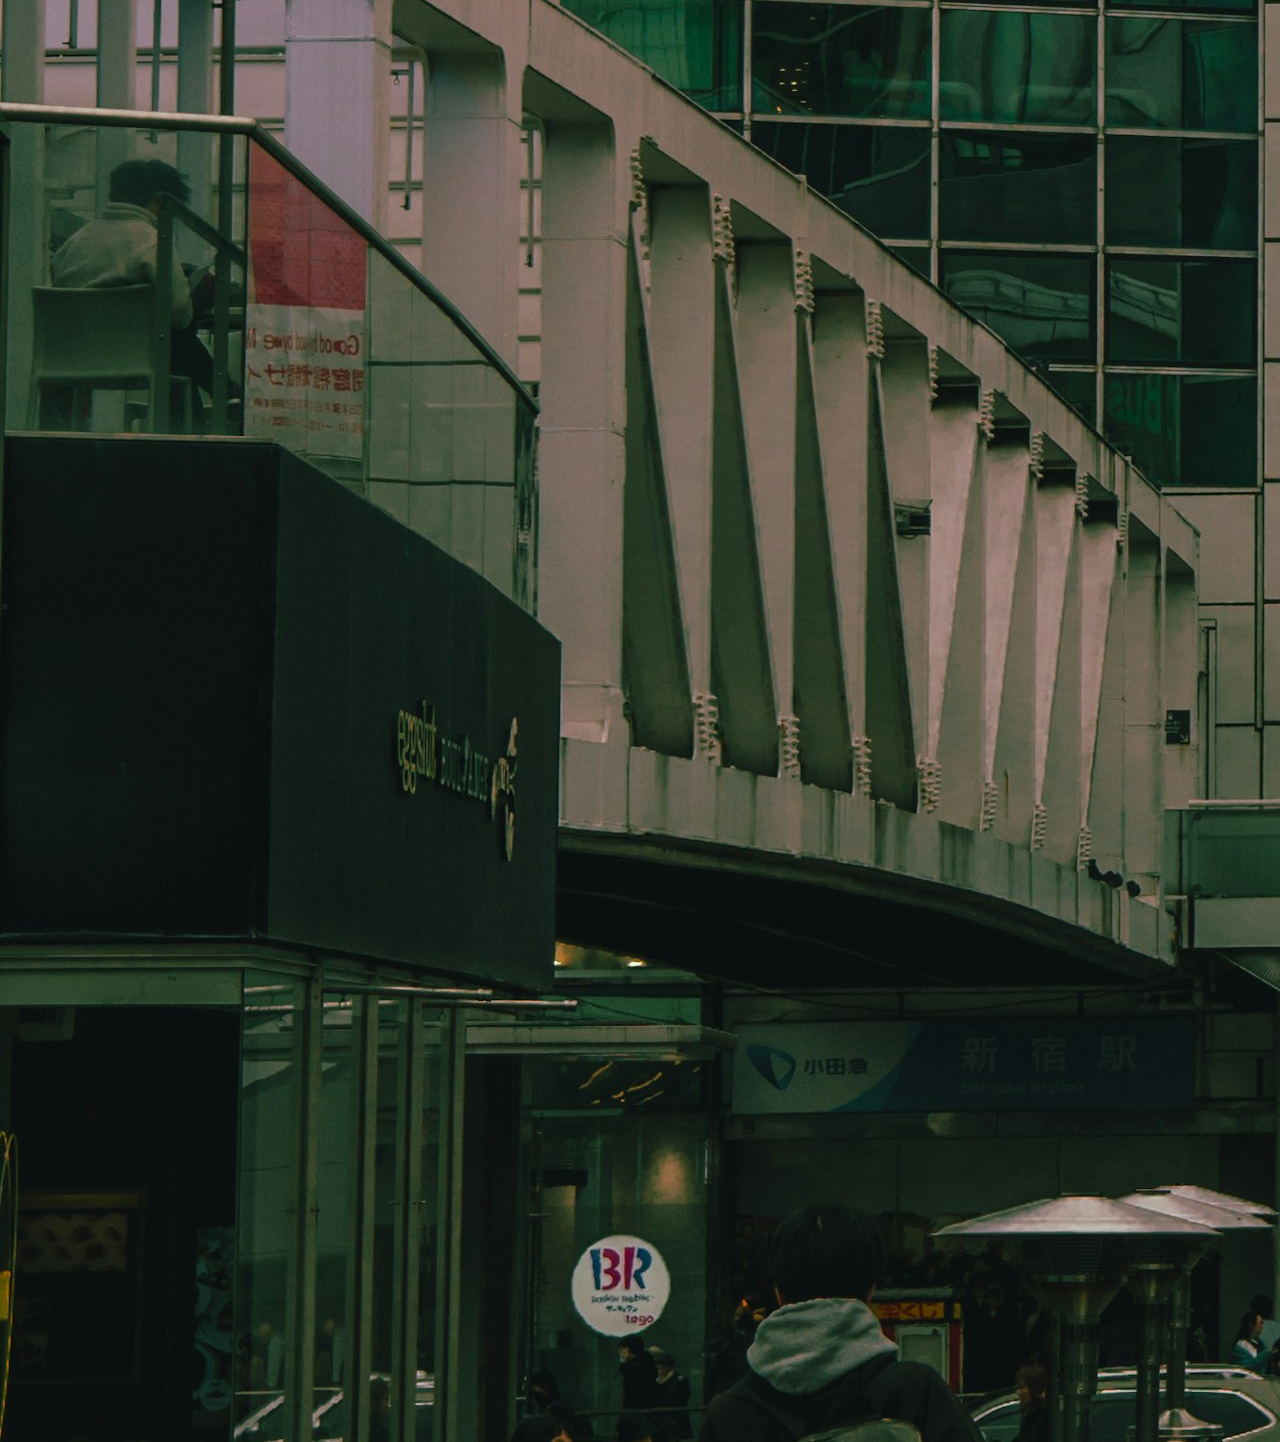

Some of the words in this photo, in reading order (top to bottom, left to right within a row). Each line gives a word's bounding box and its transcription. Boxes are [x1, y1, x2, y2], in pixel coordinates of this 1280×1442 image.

[804, 1057, 868, 1076] 小田急
[960, 1034, 1138, 1074] 新宿駅
[960, 1080, 1026, 1098] Shinjuku
[1030, 1080, 1084, 1094] Station
[590, 1246, 652, 1290] BR
